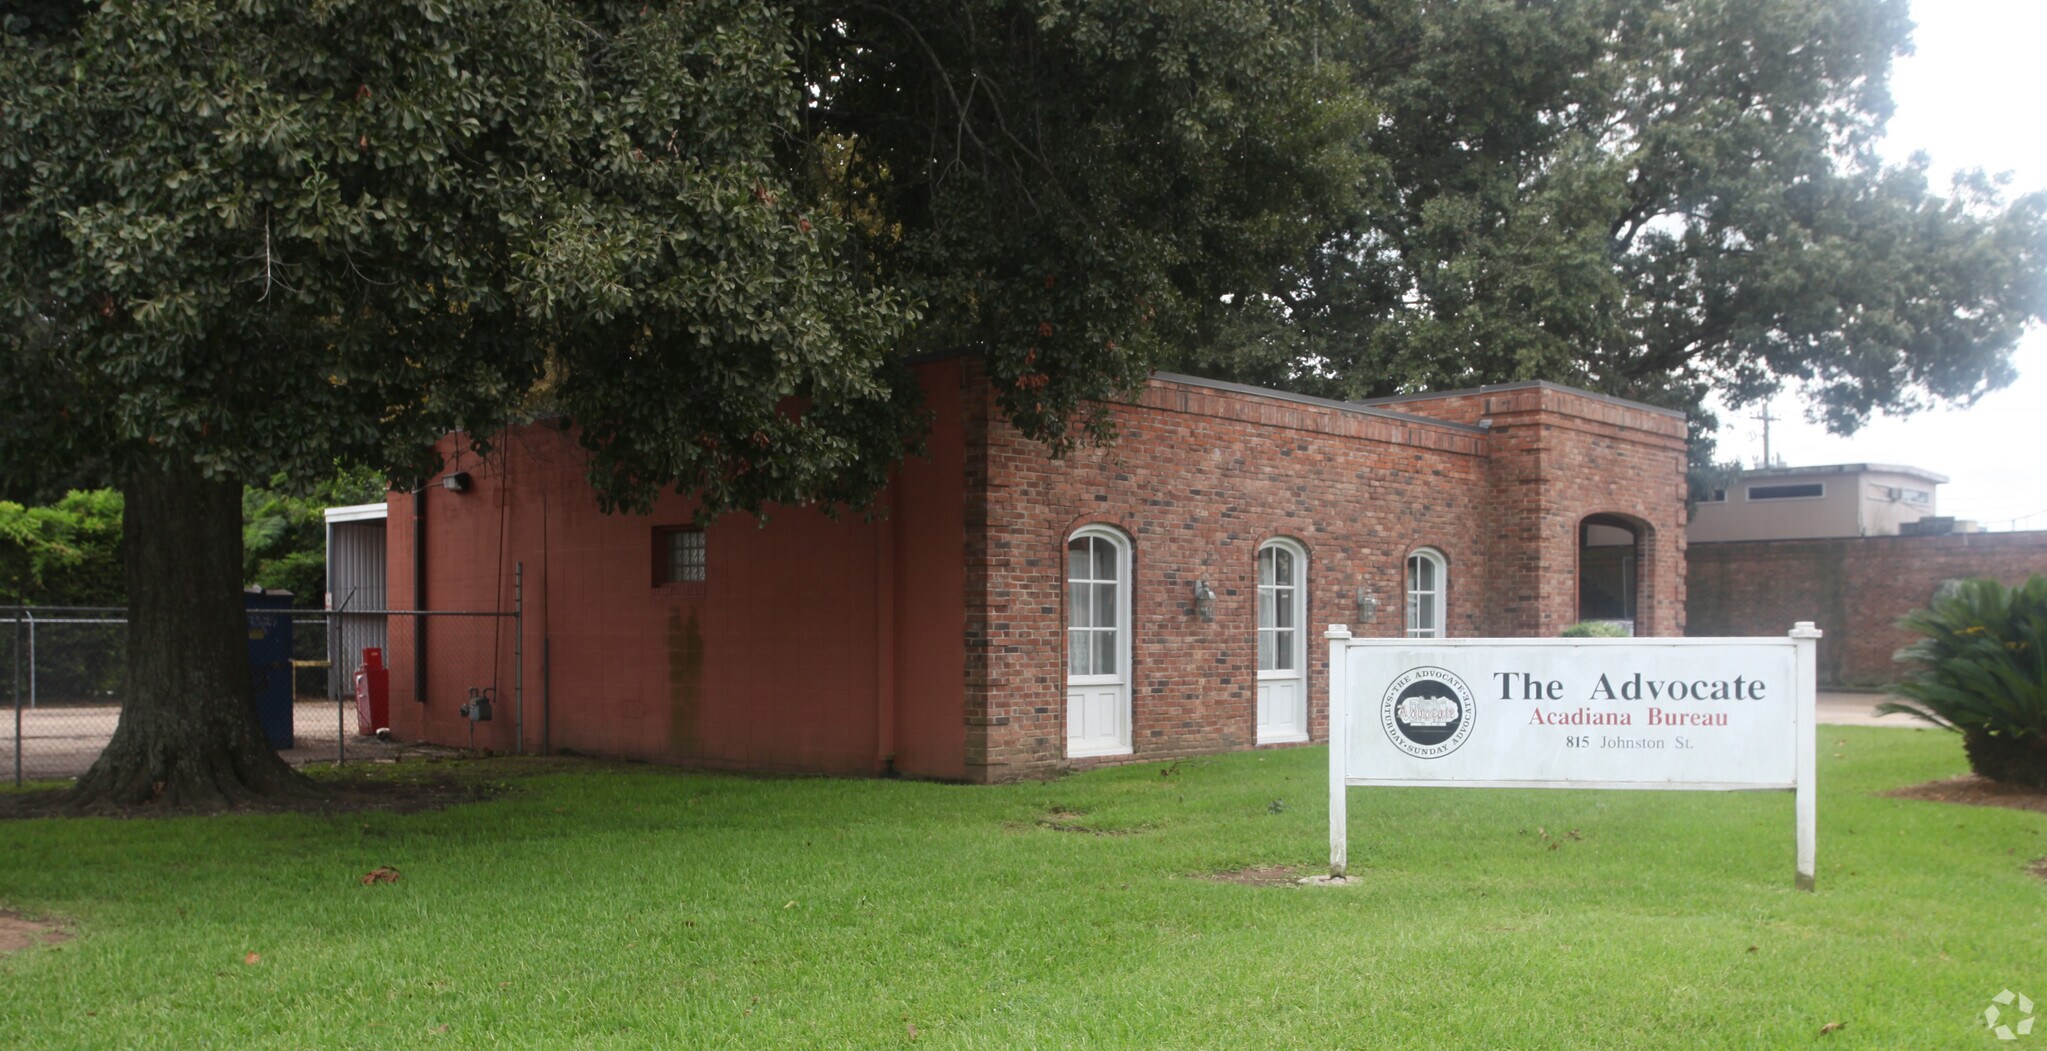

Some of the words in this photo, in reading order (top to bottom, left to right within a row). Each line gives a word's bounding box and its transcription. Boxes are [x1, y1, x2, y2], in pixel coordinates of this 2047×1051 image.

[1392, 675, 1411, 693] THE
[1415, 670, 1466, 693] ADVOCATE
[1493, 672, 1564, 701] The
[1590, 672, 1766, 701] Advocate
[1384, 695, 1406, 746] SATURDAY
[1407, 744, 1448, 755] SUNDAY
[1452, 694, 1472, 745] ADVOCATE
[1528, 707, 1632, 726] Acadiana
[1648, 707, 1728, 726] Bureau
[1566, 735, 1590, 748] 815
[1600, 735, 1665, 749] Johnston
[1675, 736, 1694, 749] St.
